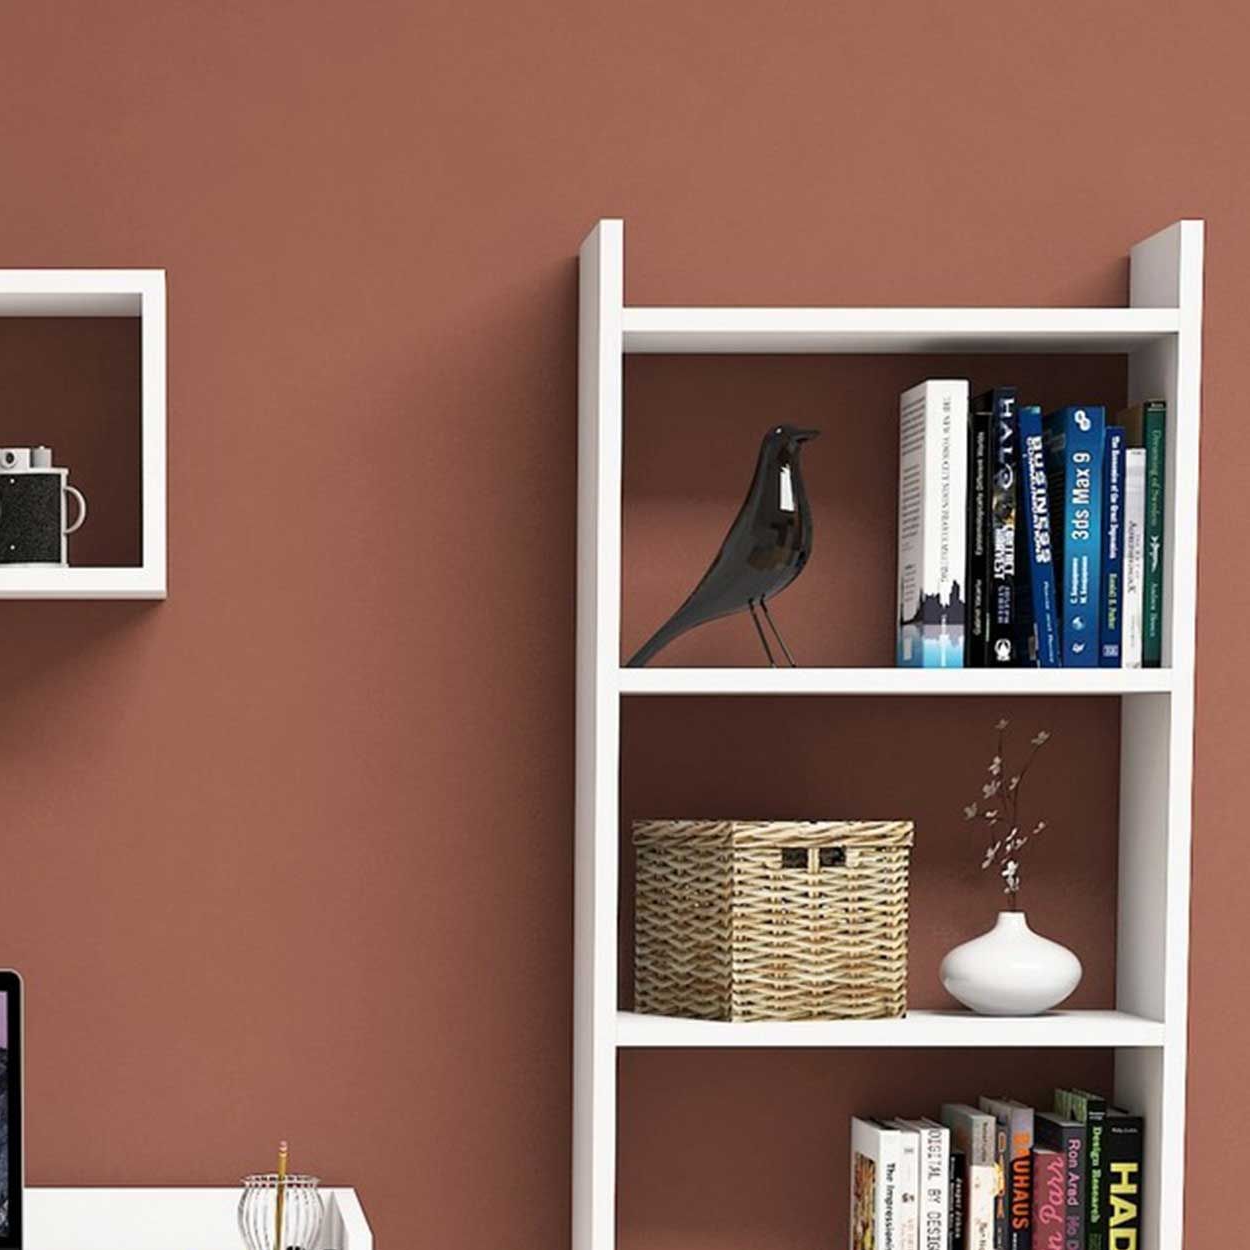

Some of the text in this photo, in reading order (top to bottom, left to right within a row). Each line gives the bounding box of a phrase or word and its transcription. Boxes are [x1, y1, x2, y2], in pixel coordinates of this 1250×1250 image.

[999, 397, 1014, 490] HALO
[1073, 452, 1091, 463] 9
[1033, 436, 1052, 563] BUSINESS
[1072, 468, 1090, 504] Max
[1071, 510, 1090, 540] 3ds
[927, 1129, 943, 1180] DIGITAL
[1068, 1139, 1081, 1170] Ron
[1090, 1126, 1102, 1166] Design
[886, 1163, 895, 1182] The
[1012, 1130, 1030, 1230] BAUHAUS
[1067, 1172, 1080, 1206] Arad
[927, 1189, 941, 1204] BY
[1038, 1157, 1064, 1225] Parr
[1089, 1169, 1102, 1223] Research
[1066, 1215, 1079, 1235] No
